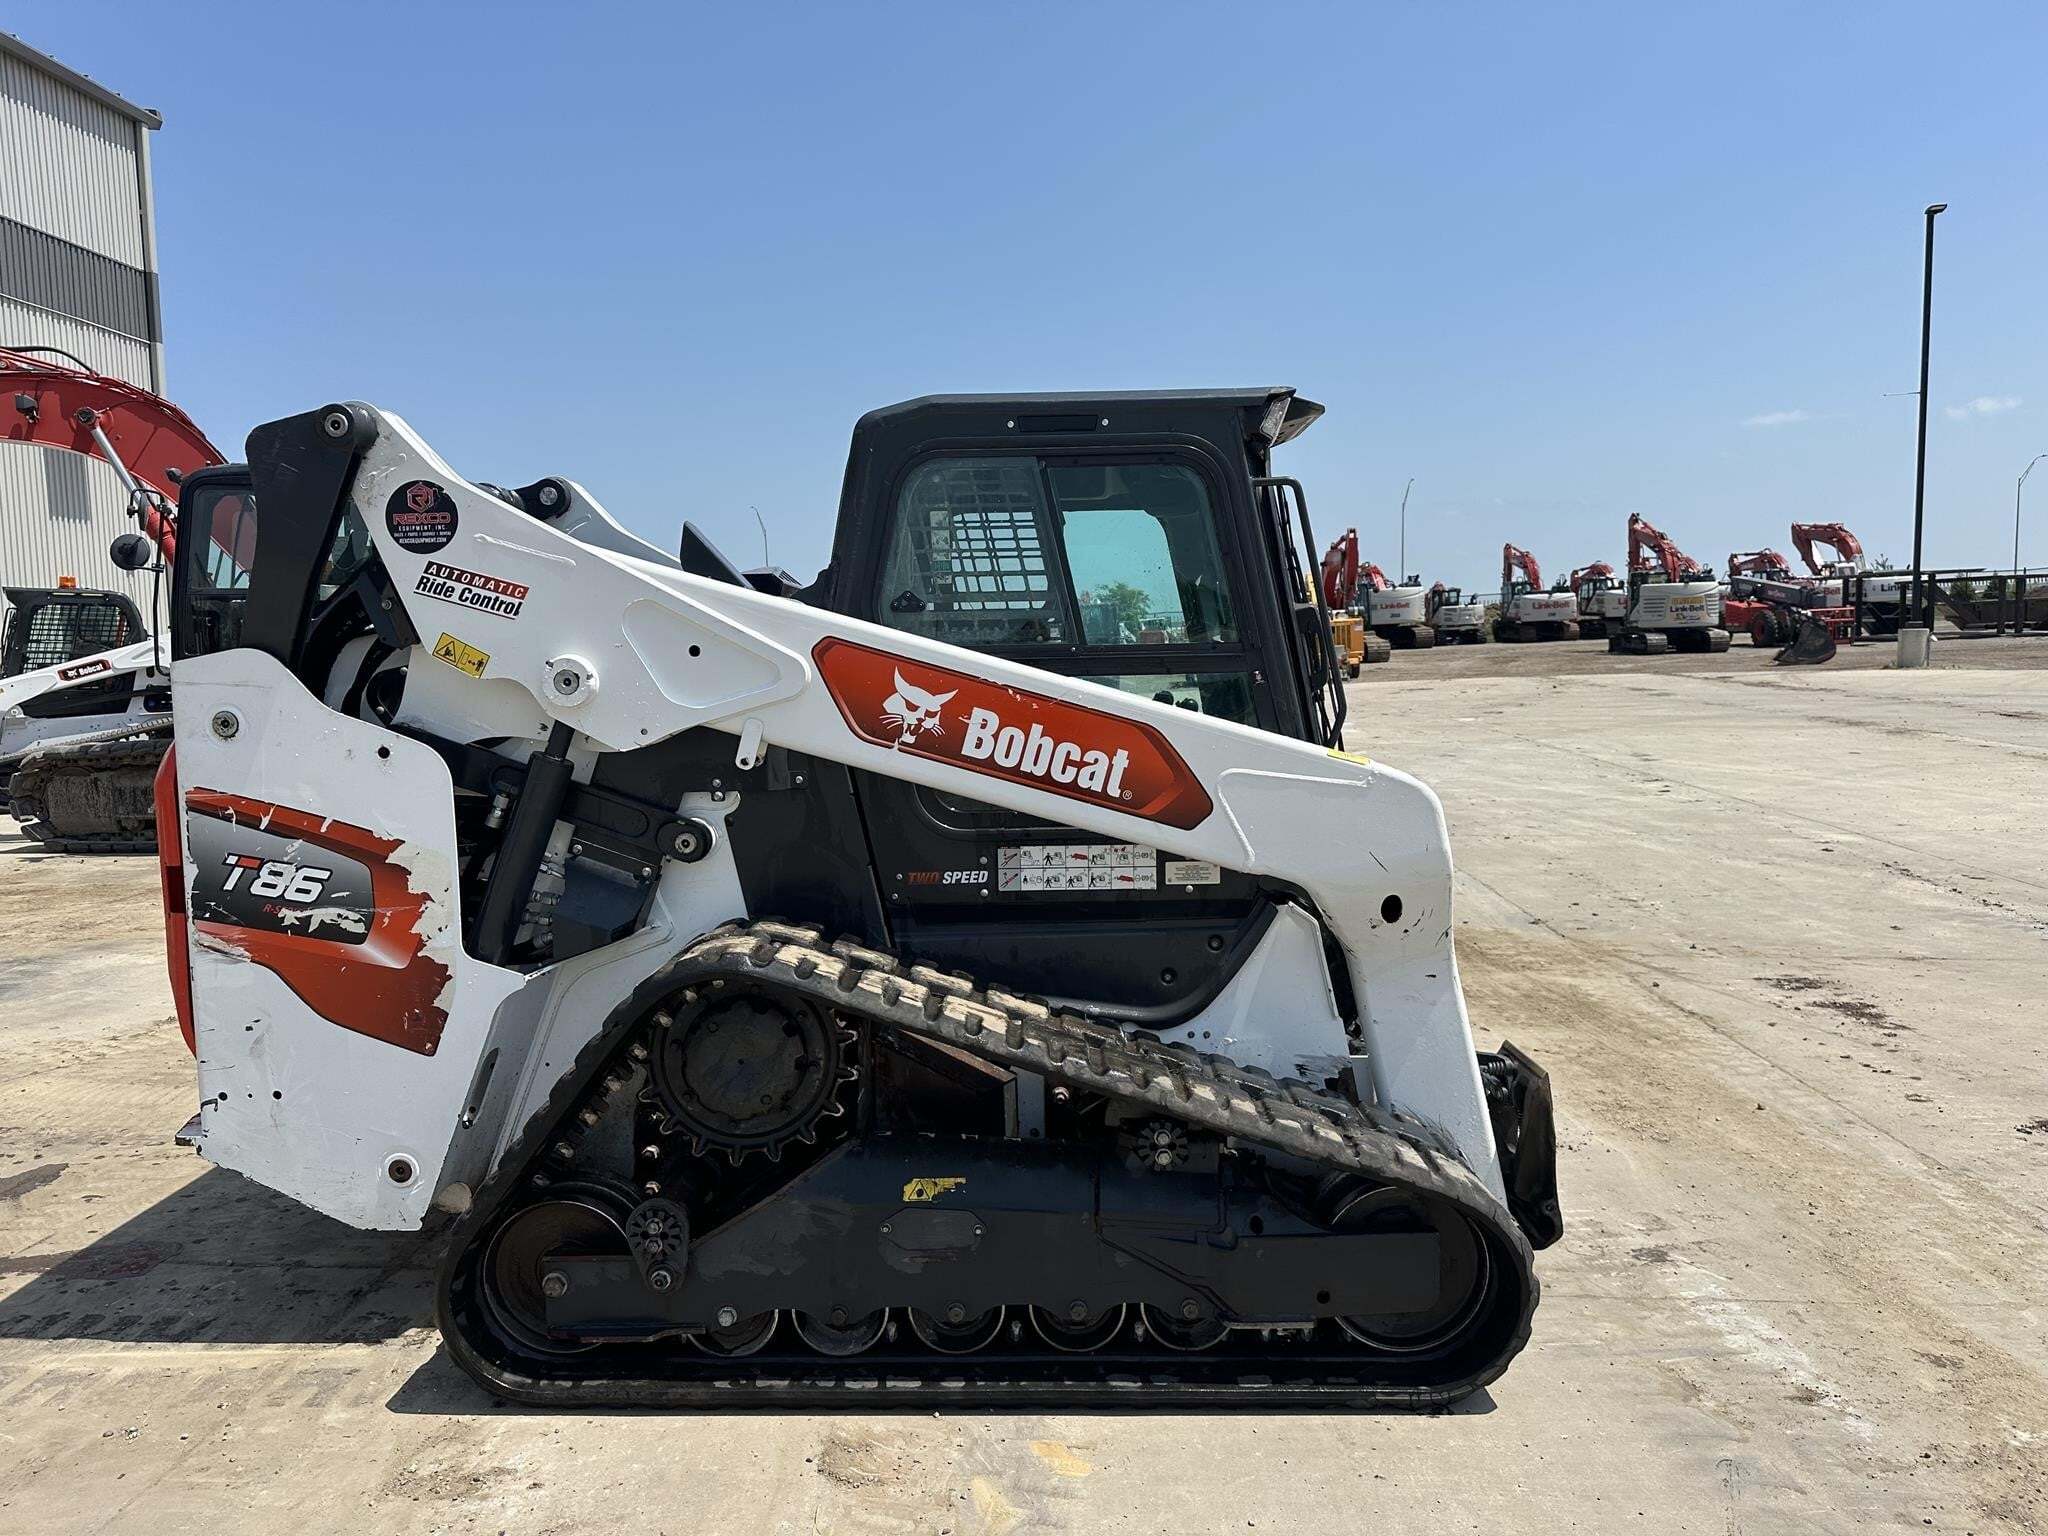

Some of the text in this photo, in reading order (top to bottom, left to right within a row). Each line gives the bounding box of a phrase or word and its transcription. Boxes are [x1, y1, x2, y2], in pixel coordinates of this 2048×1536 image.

[393, 512, 451, 525] REXCO
[415, 575, 523, 616] Ride Control
[428, 564, 525, 598] AUTOMATIC
[79, 663, 104, 676] Bobcat
[961, 707, 1129, 798] Bobcat
[223, 853, 332, 903] T86
[908, 870, 989, 885] TWO SPEED
